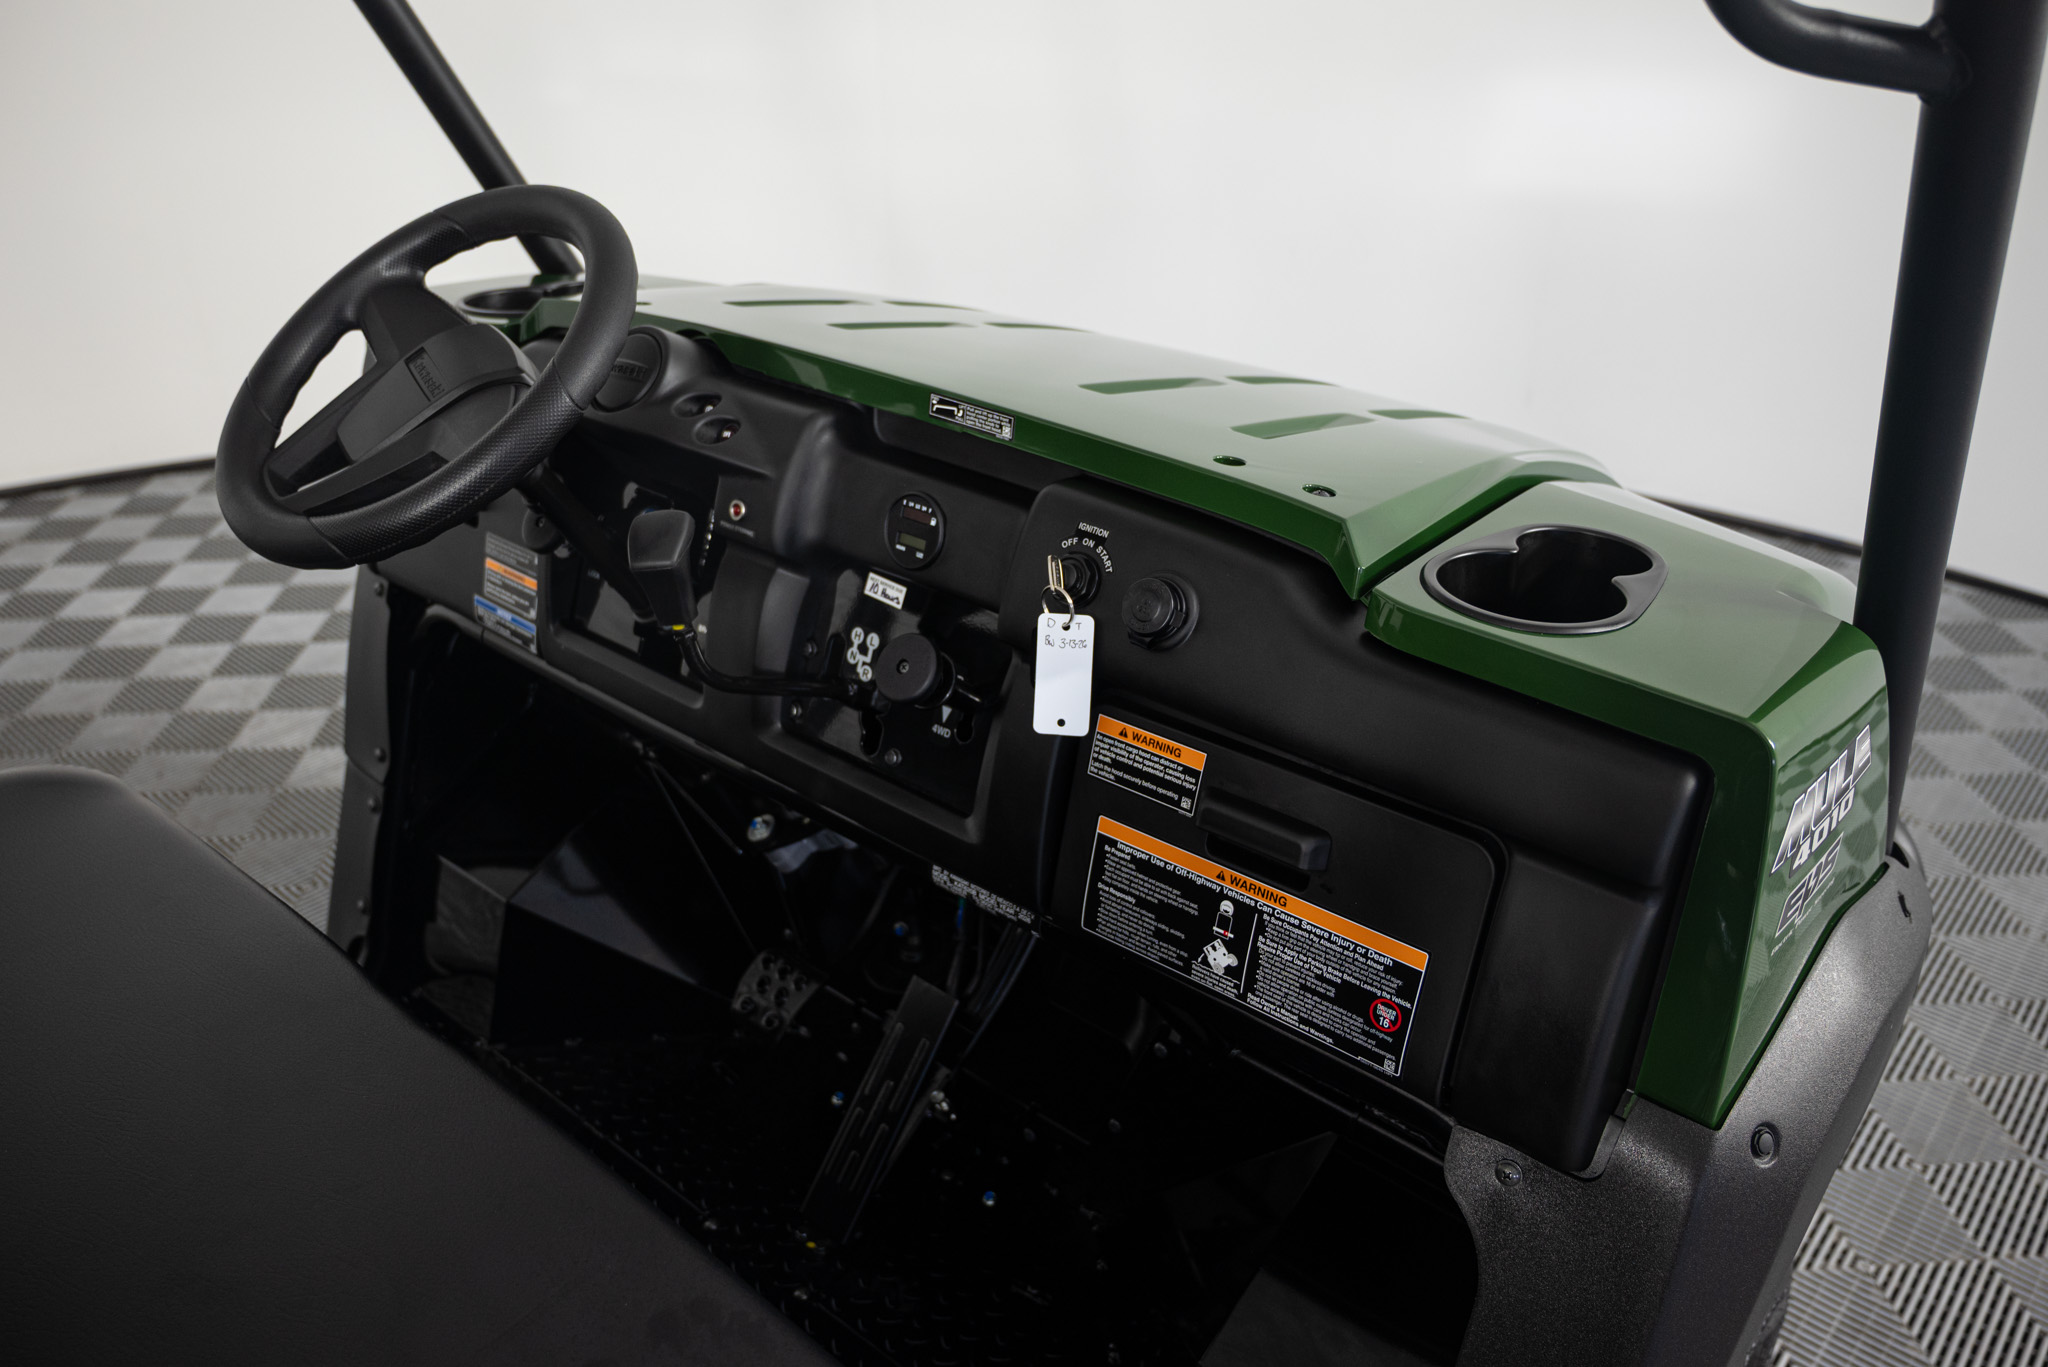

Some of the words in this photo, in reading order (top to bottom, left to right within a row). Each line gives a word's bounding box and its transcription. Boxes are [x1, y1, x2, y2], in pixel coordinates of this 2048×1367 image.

[1078, 522, 1109, 538] IGNITION
[1061, 537, 1079, 548] OFF
[1082, 538, 1095, 548] ON
[1096, 546, 1113, 573] START
[932, 724, 951, 738] 4WD
[1131, 731, 1182, 759] WARNING
[1770, 723, 1872, 876] MULE
[1793, 788, 1854, 871] 4010
[1111, 847, 1131, 861] Prepared
[1098, 882, 1109, 892] Drive
[1109, 887, 1136, 905] Responsibly
[1229, 875, 1288, 907] WARNING
[1775, 832, 1844, 938] EPS
[1117, 842, 1149, 861] Improper
[1150, 856, 1165, 868] Use
[1166, 864, 1174, 872] of
[1175, 867, 1221, 893] Off-Highway
[1223, 887, 1255, 907] Vehicles
[1257, 902, 1272, 914] Can
[1275, 910, 1299, 926] Cause
[1301, 921, 1329, 939] Severe
[1331, 934, 1355, 951] Injury
[1356, 946, 1366, 955] or
[1368, 950, 1393, 967] Death
[1263, 913, 1270, 921] Be
[1270, 917, 1282, 927] Sure
[1282, 922, 1309, 938] Occupants
[1309, 934, 1320, 944] Pay
[1320, 938, 1343, 953] Attention
[1343, 950, 1354, 958] and
[1354, 953, 1366, 963] Plan
[1366, 959, 1384, 971] Ahead
[1257, 941, 1276, 954] Require
[1276, 950, 1293, 962] Proper
[1294, 958, 1303, 967] Use
[1309, 965, 1322, 975] Your
[1322, 971, 1342, 984] Vehicle
[1258, 935, 1265, 943] Be
[1265, 939, 1277, 949] Sure
[1284, 947, 1298, 959] Apply
[1298, 953, 1307, 962] the
[1308, 957, 1327, 972] Parking
[1327, 966, 1342, 978] Brake
[1343, 973, 1360, 986] Before
[1360, 981, 1381, 996] Leaving
[1382, 990, 1391, 999] the
[1391, 995, 1412, 1009] Vehicle.
[1246, 997, 1263, 1009] Follow
[1270, 1009, 1299, 1027] Instructions
[1299, 1024, 1309, 1032] and
[1309, 1027, 1334, 1044] Warnings.
[1247, 992, 1260, 1002] Read
[1260, 999, 1280, 1012] Owner's
[1280, 1008, 1299, 1021] Manual.
[1379, 1016, 1389, 1028] 16
